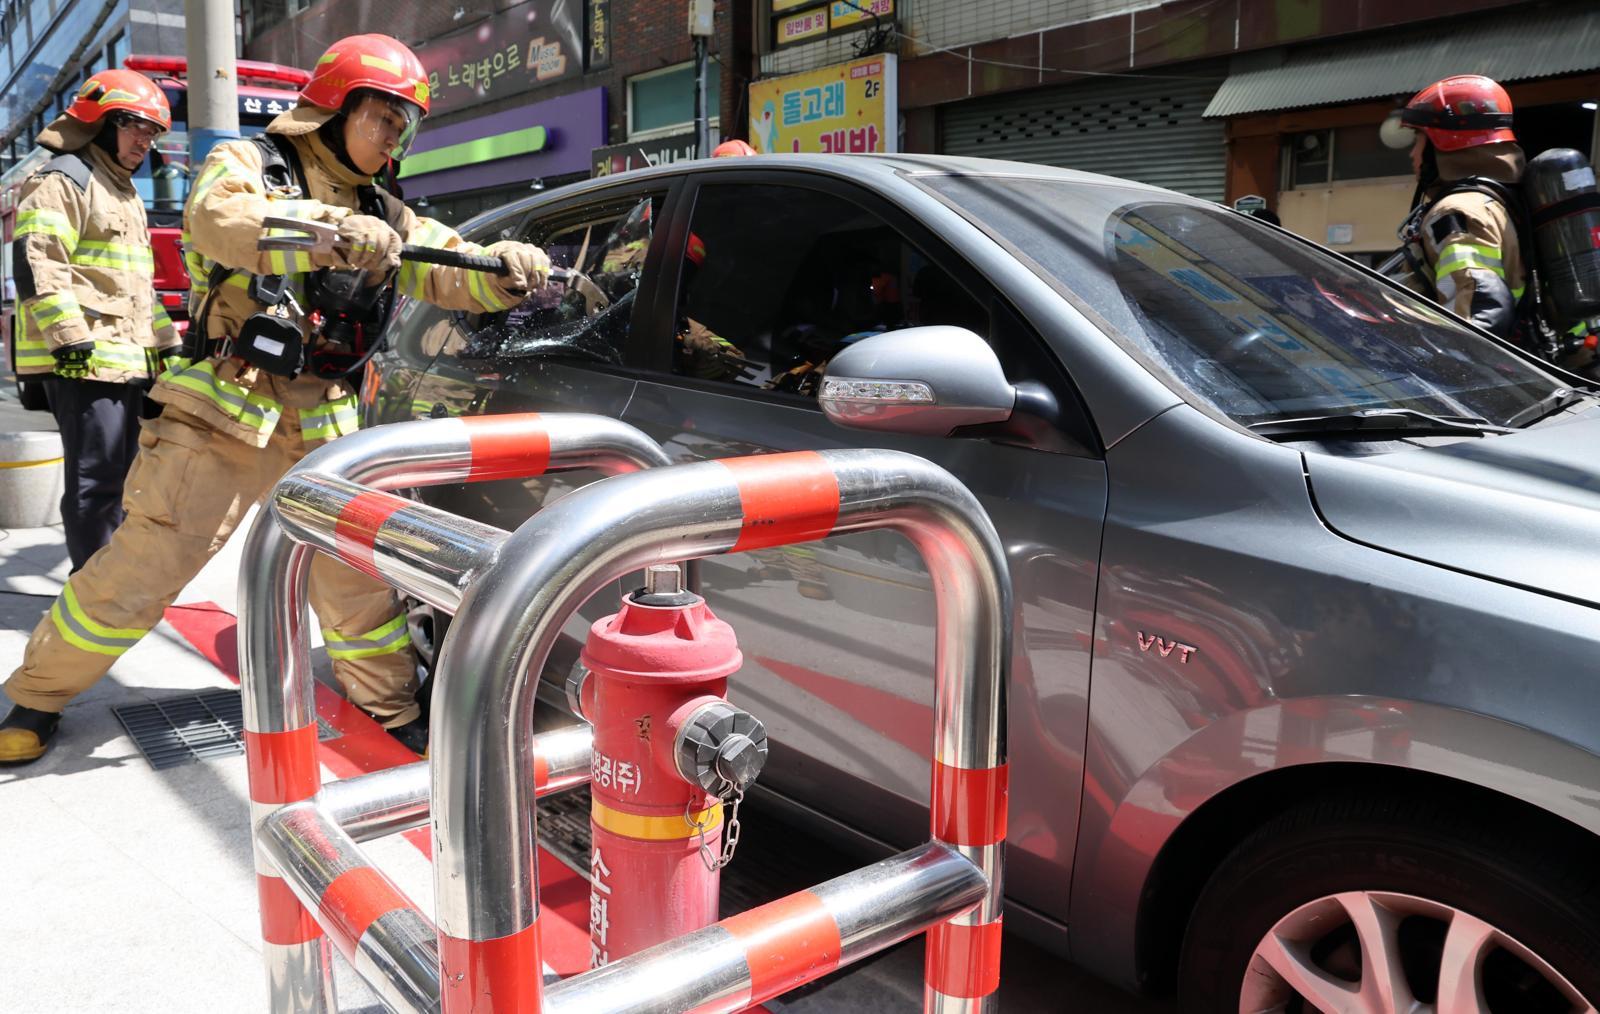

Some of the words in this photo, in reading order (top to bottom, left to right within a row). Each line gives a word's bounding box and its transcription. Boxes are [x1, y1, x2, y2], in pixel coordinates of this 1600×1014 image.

[447, 43, 521, 89] 노래방으로
[783, 80, 845, 126] 돌고래
[865, 79, 880, 98] 2F
[1137, 631, 1197, 664] VVT
